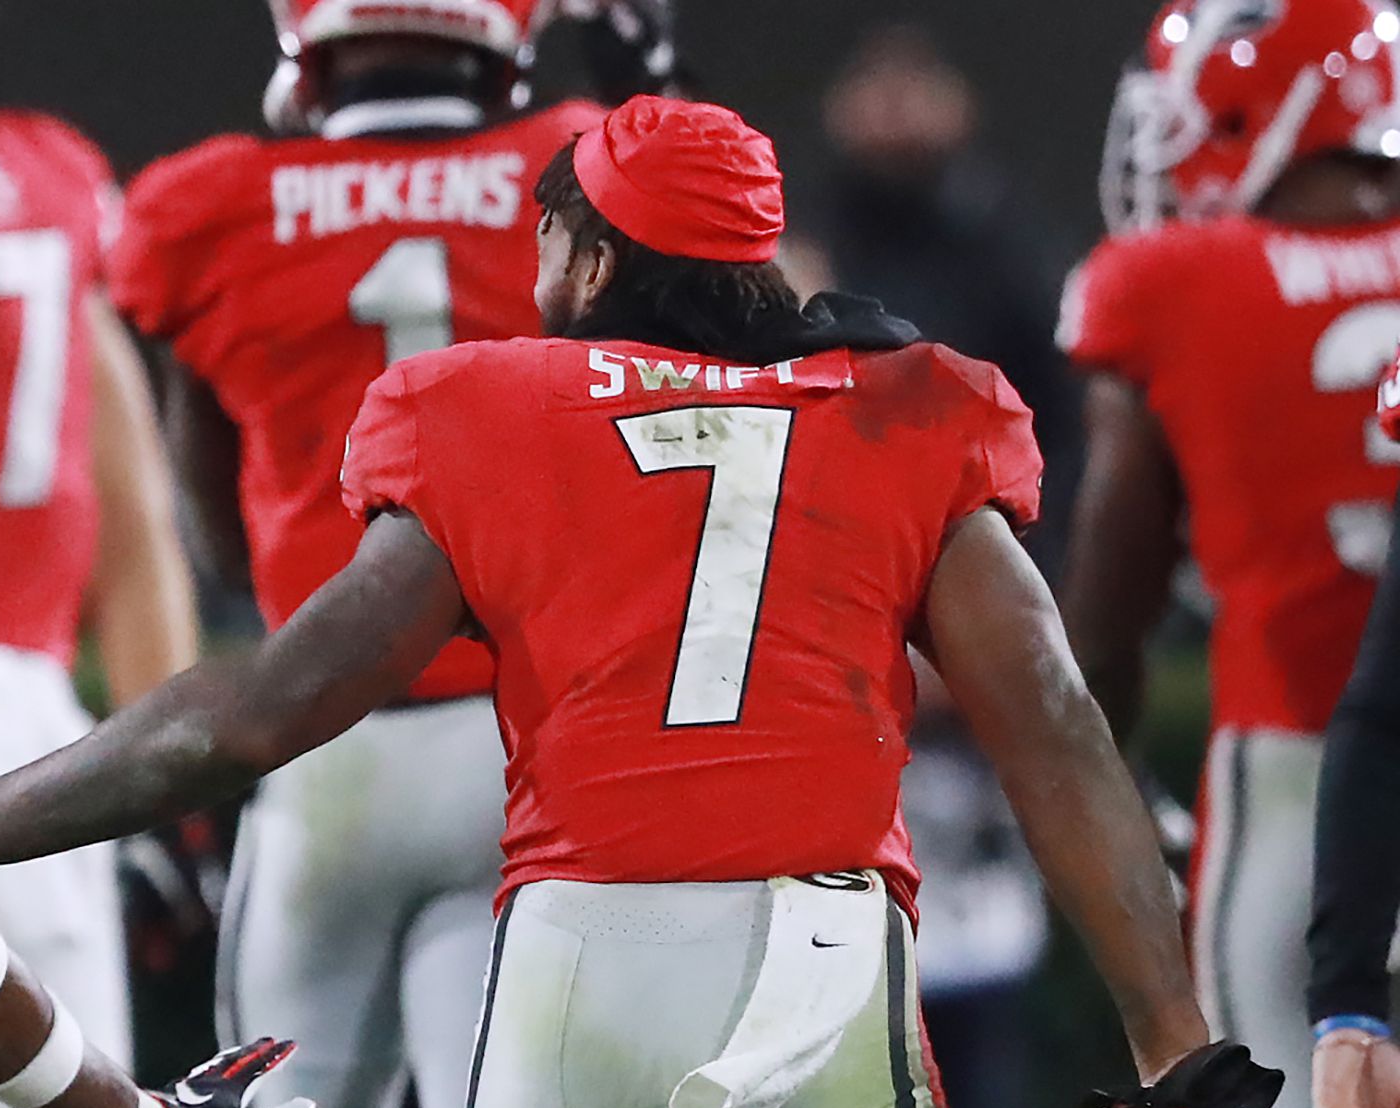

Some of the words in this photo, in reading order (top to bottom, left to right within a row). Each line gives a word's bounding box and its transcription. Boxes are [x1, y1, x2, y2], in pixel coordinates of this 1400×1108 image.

[270, 152, 526, 244] PICKENS
[588, 347, 804, 399] SWIFT
[611, 404, 796, 729] 7
